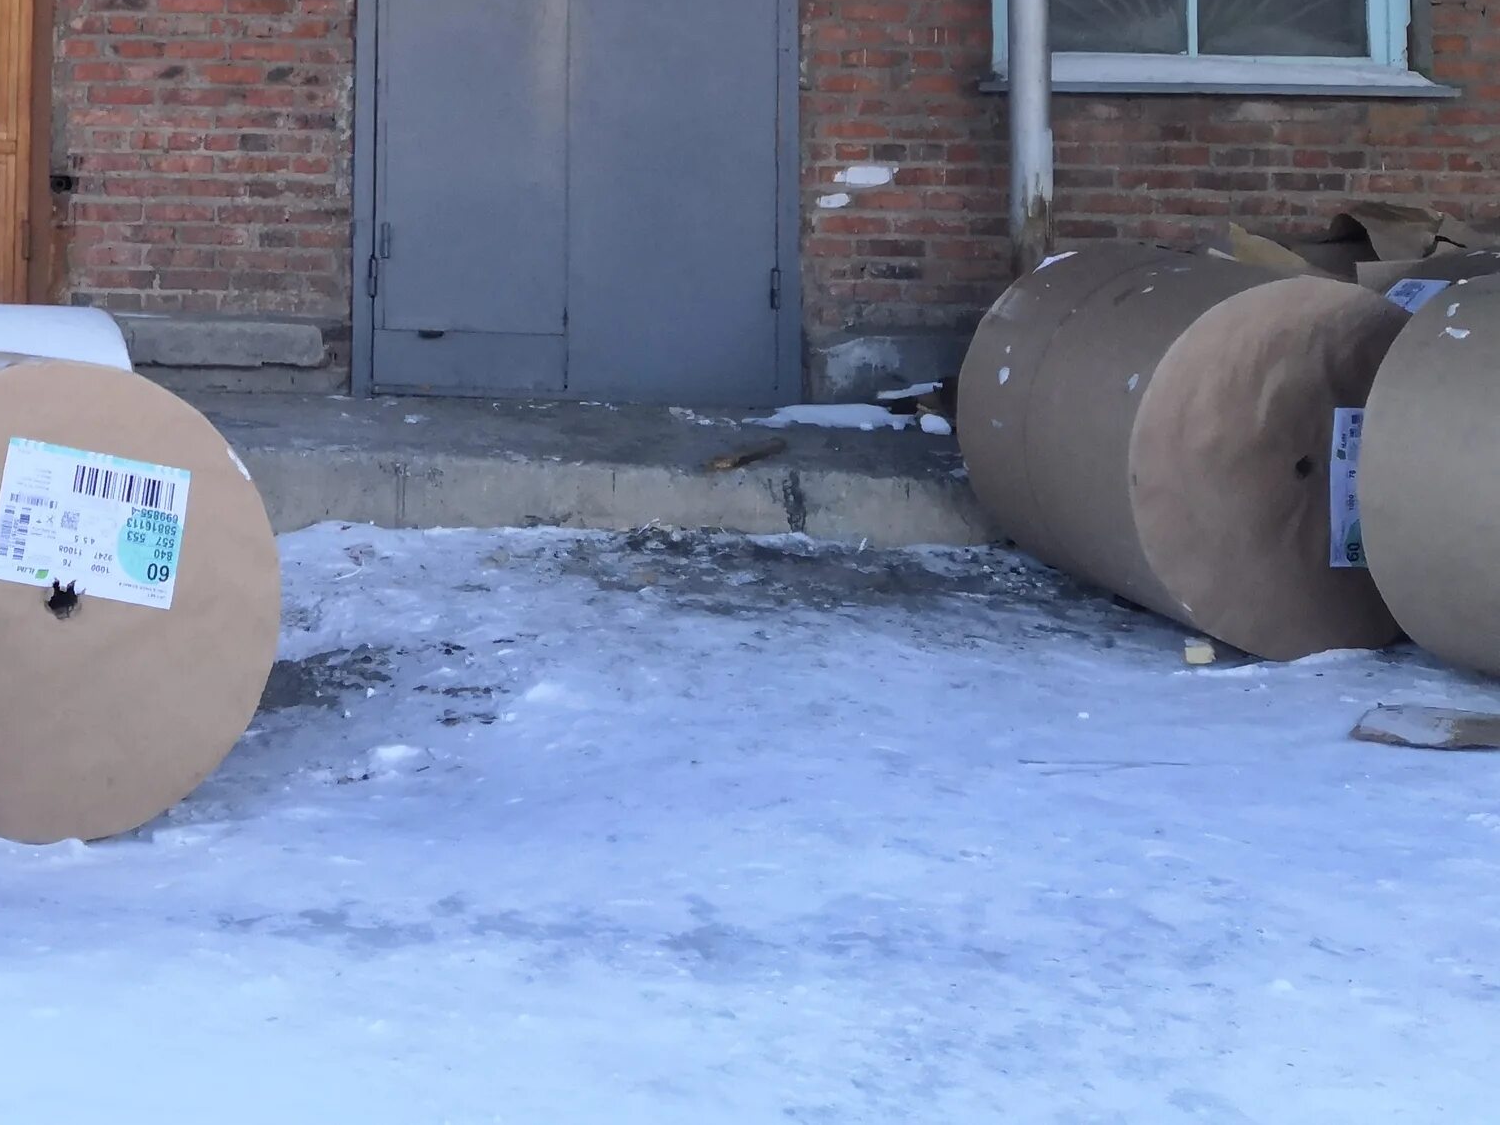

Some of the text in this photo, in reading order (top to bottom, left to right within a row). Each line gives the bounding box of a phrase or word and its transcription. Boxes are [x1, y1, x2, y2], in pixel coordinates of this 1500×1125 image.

[156, 536, 175, 548] 557
[154, 549, 173, 562] 840
[1347, 542, 1360, 562] 60
[147, 563, 170, 582] 60
